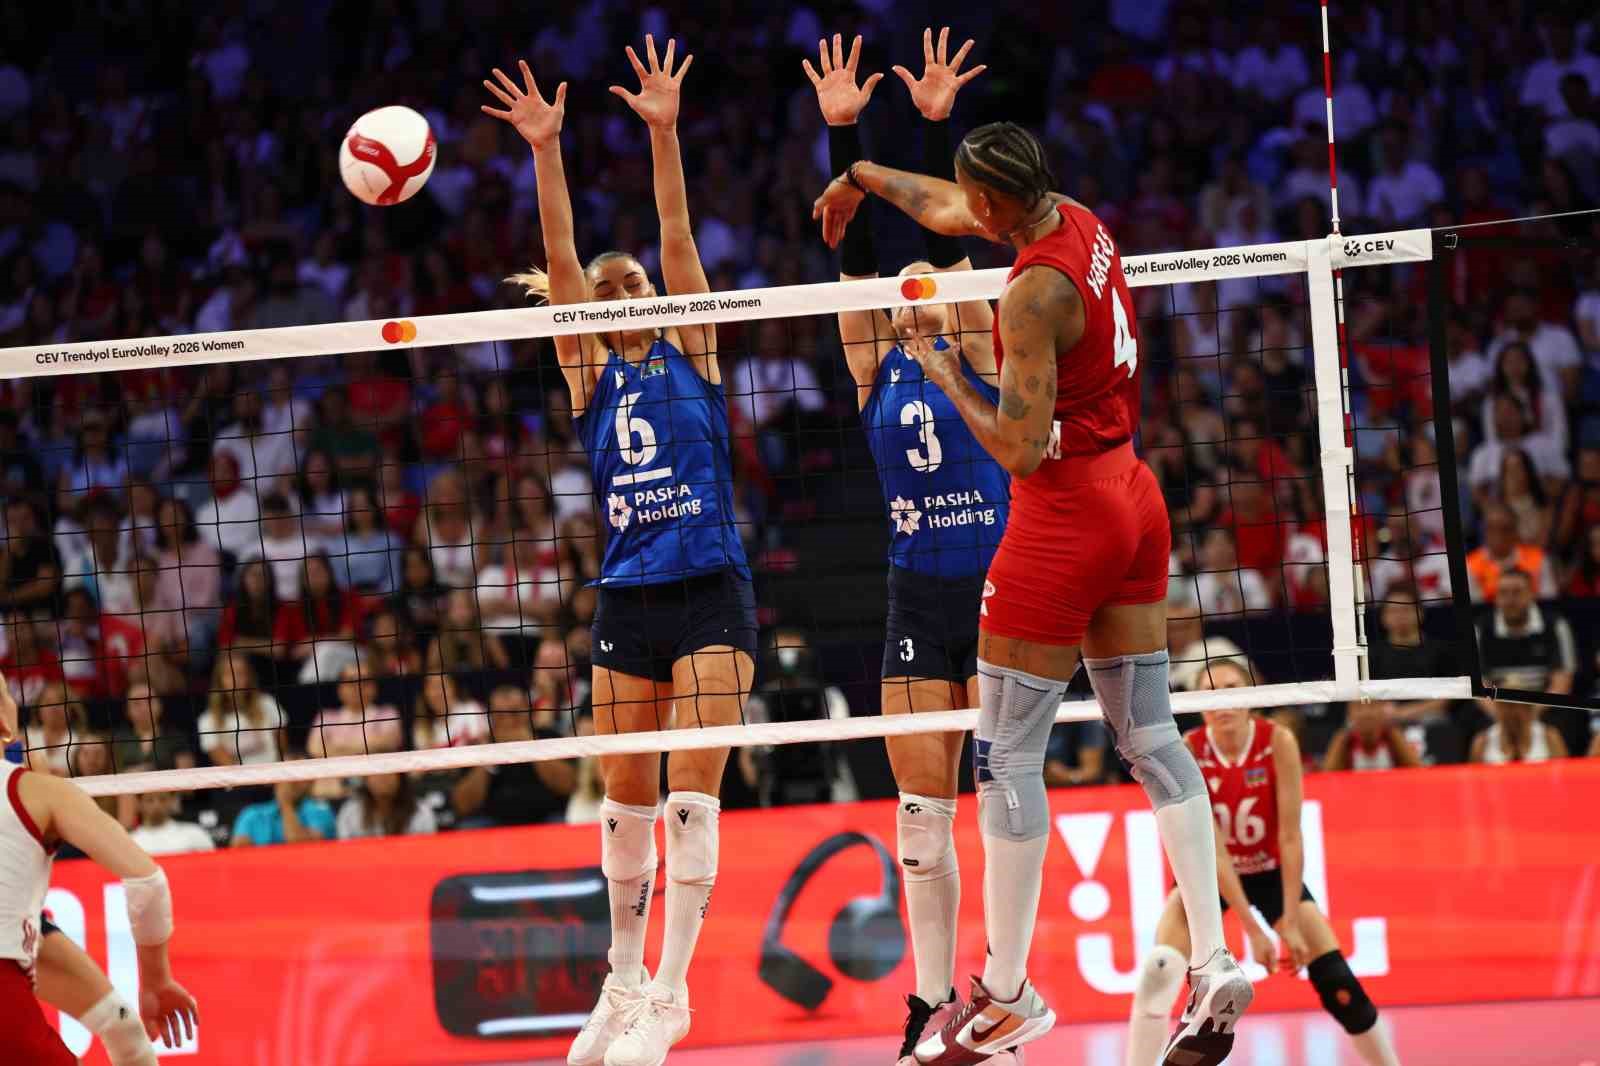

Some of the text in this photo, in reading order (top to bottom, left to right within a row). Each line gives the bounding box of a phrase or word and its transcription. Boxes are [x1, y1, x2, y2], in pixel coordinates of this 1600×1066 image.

[1364, 240, 1394, 252] CEV
[1123, 251, 1287, 277] dyol EuroVolley 2026 Women
[553, 298, 761, 323] CEV Trendyol EuroVolley 2026 Women
[1112, 287, 1137, 379] 4
[35, 339, 245, 365] CEV Trendyol EuroVolley 2026 Women
[615, 391, 657, 467] 6
[900, 400, 942, 473] 3
[634, 484, 692, 506] PASHA
[924, 490, 984, 509] PASHA
[637, 498, 702, 524] Holding
[928, 508, 995, 529] Holding
[899, 637, 914, 662] 3
